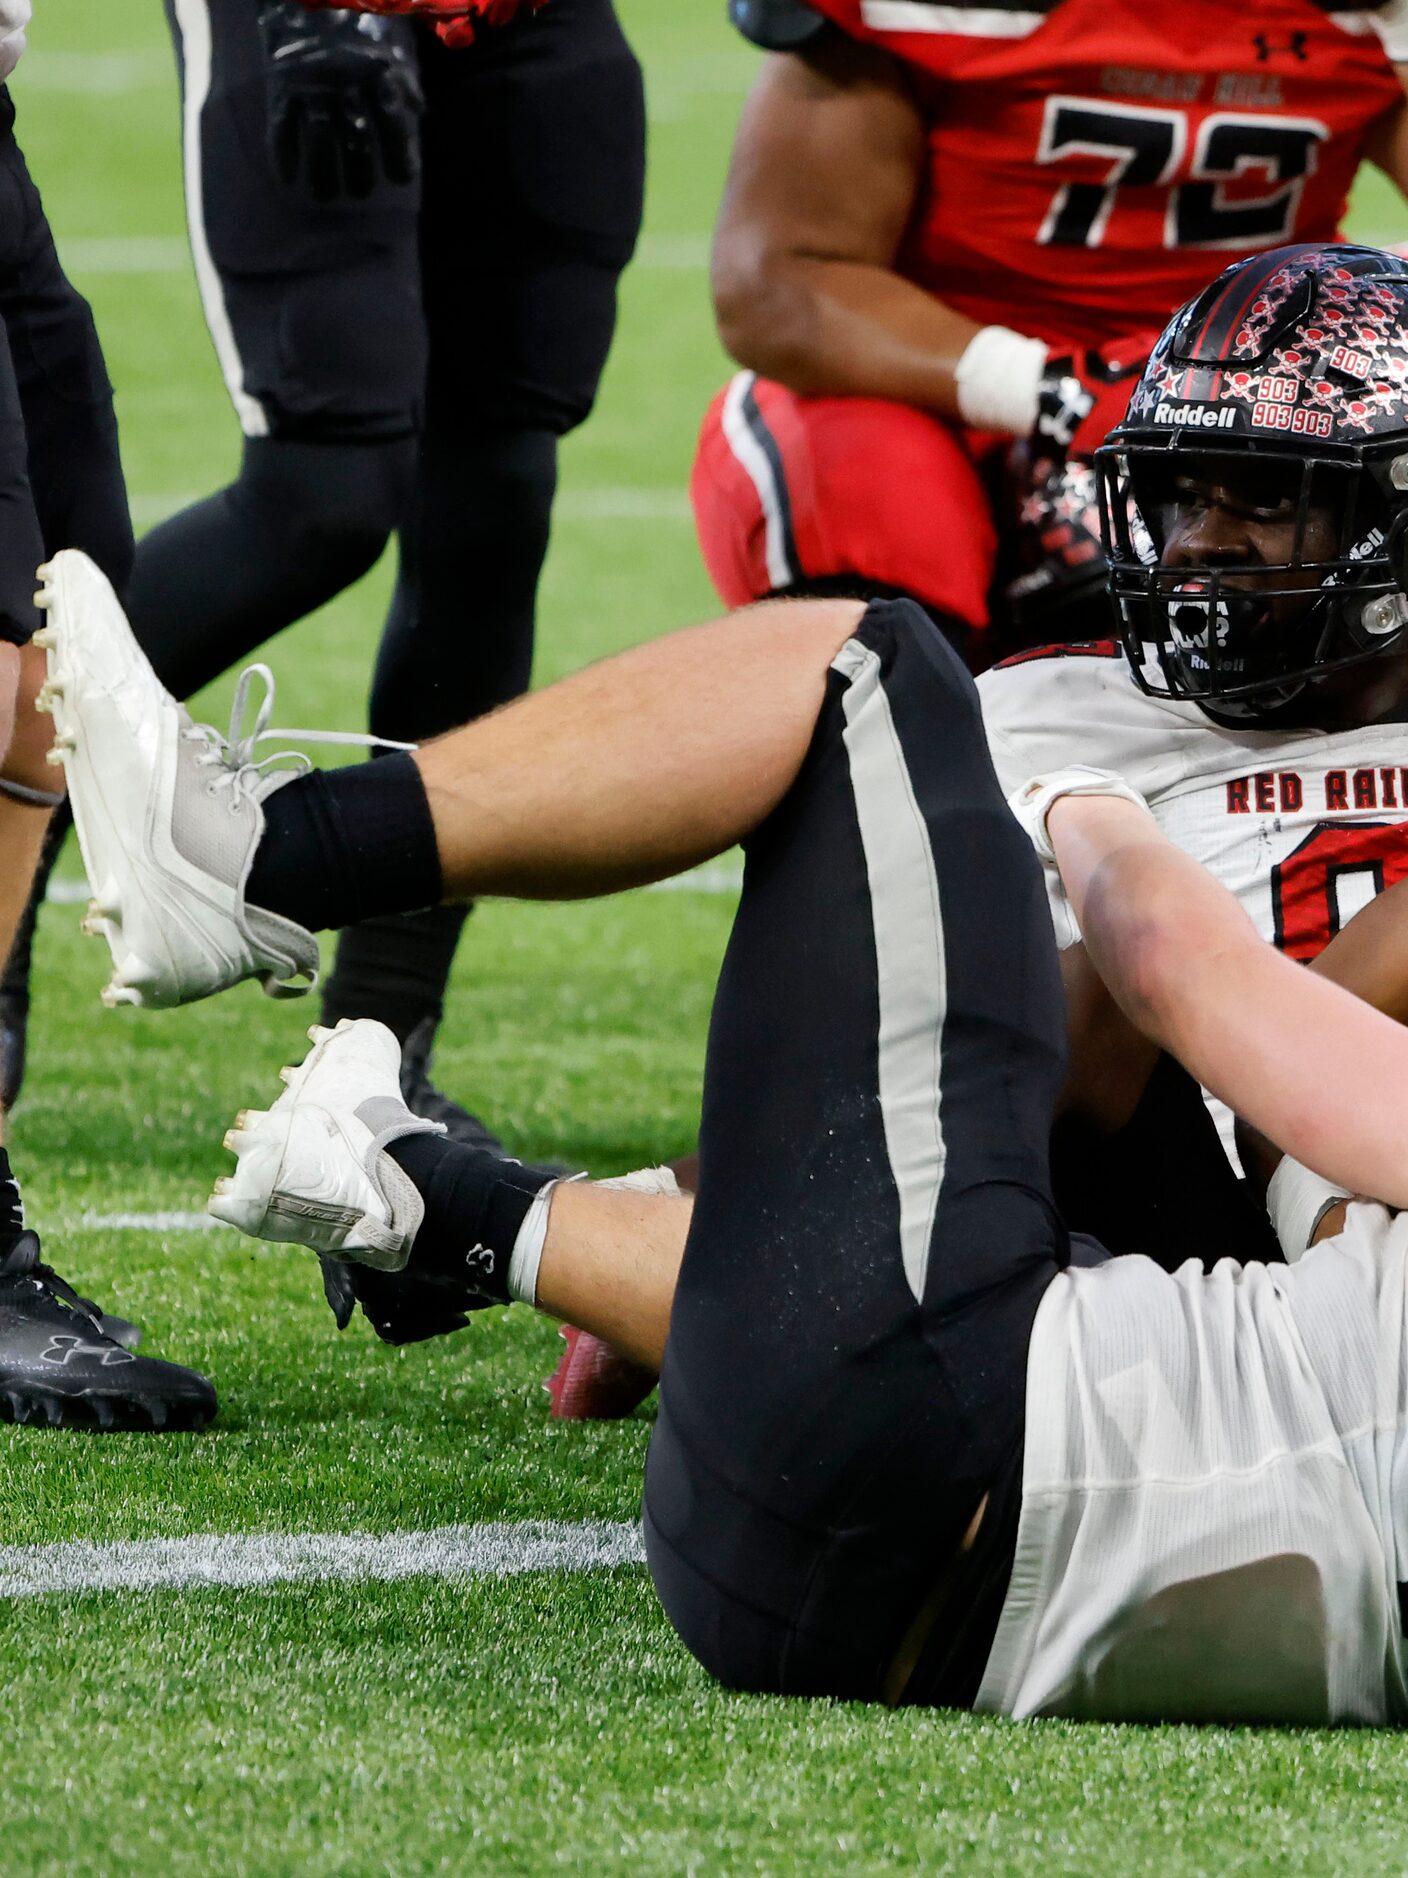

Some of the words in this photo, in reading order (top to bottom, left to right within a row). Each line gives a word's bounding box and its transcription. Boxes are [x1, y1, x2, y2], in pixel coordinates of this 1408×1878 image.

[1035, 95, 1331, 249] 72
[1330, 345, 1372, 380] 903
[1257, 376, 1299, 404] 903
[1154, 402, 1237, 429] Riddell
[1252, 401, 1293, 428] 903
[1291, 408, 1333, 437] 903
[1226, 771, 1304, 814] RED
